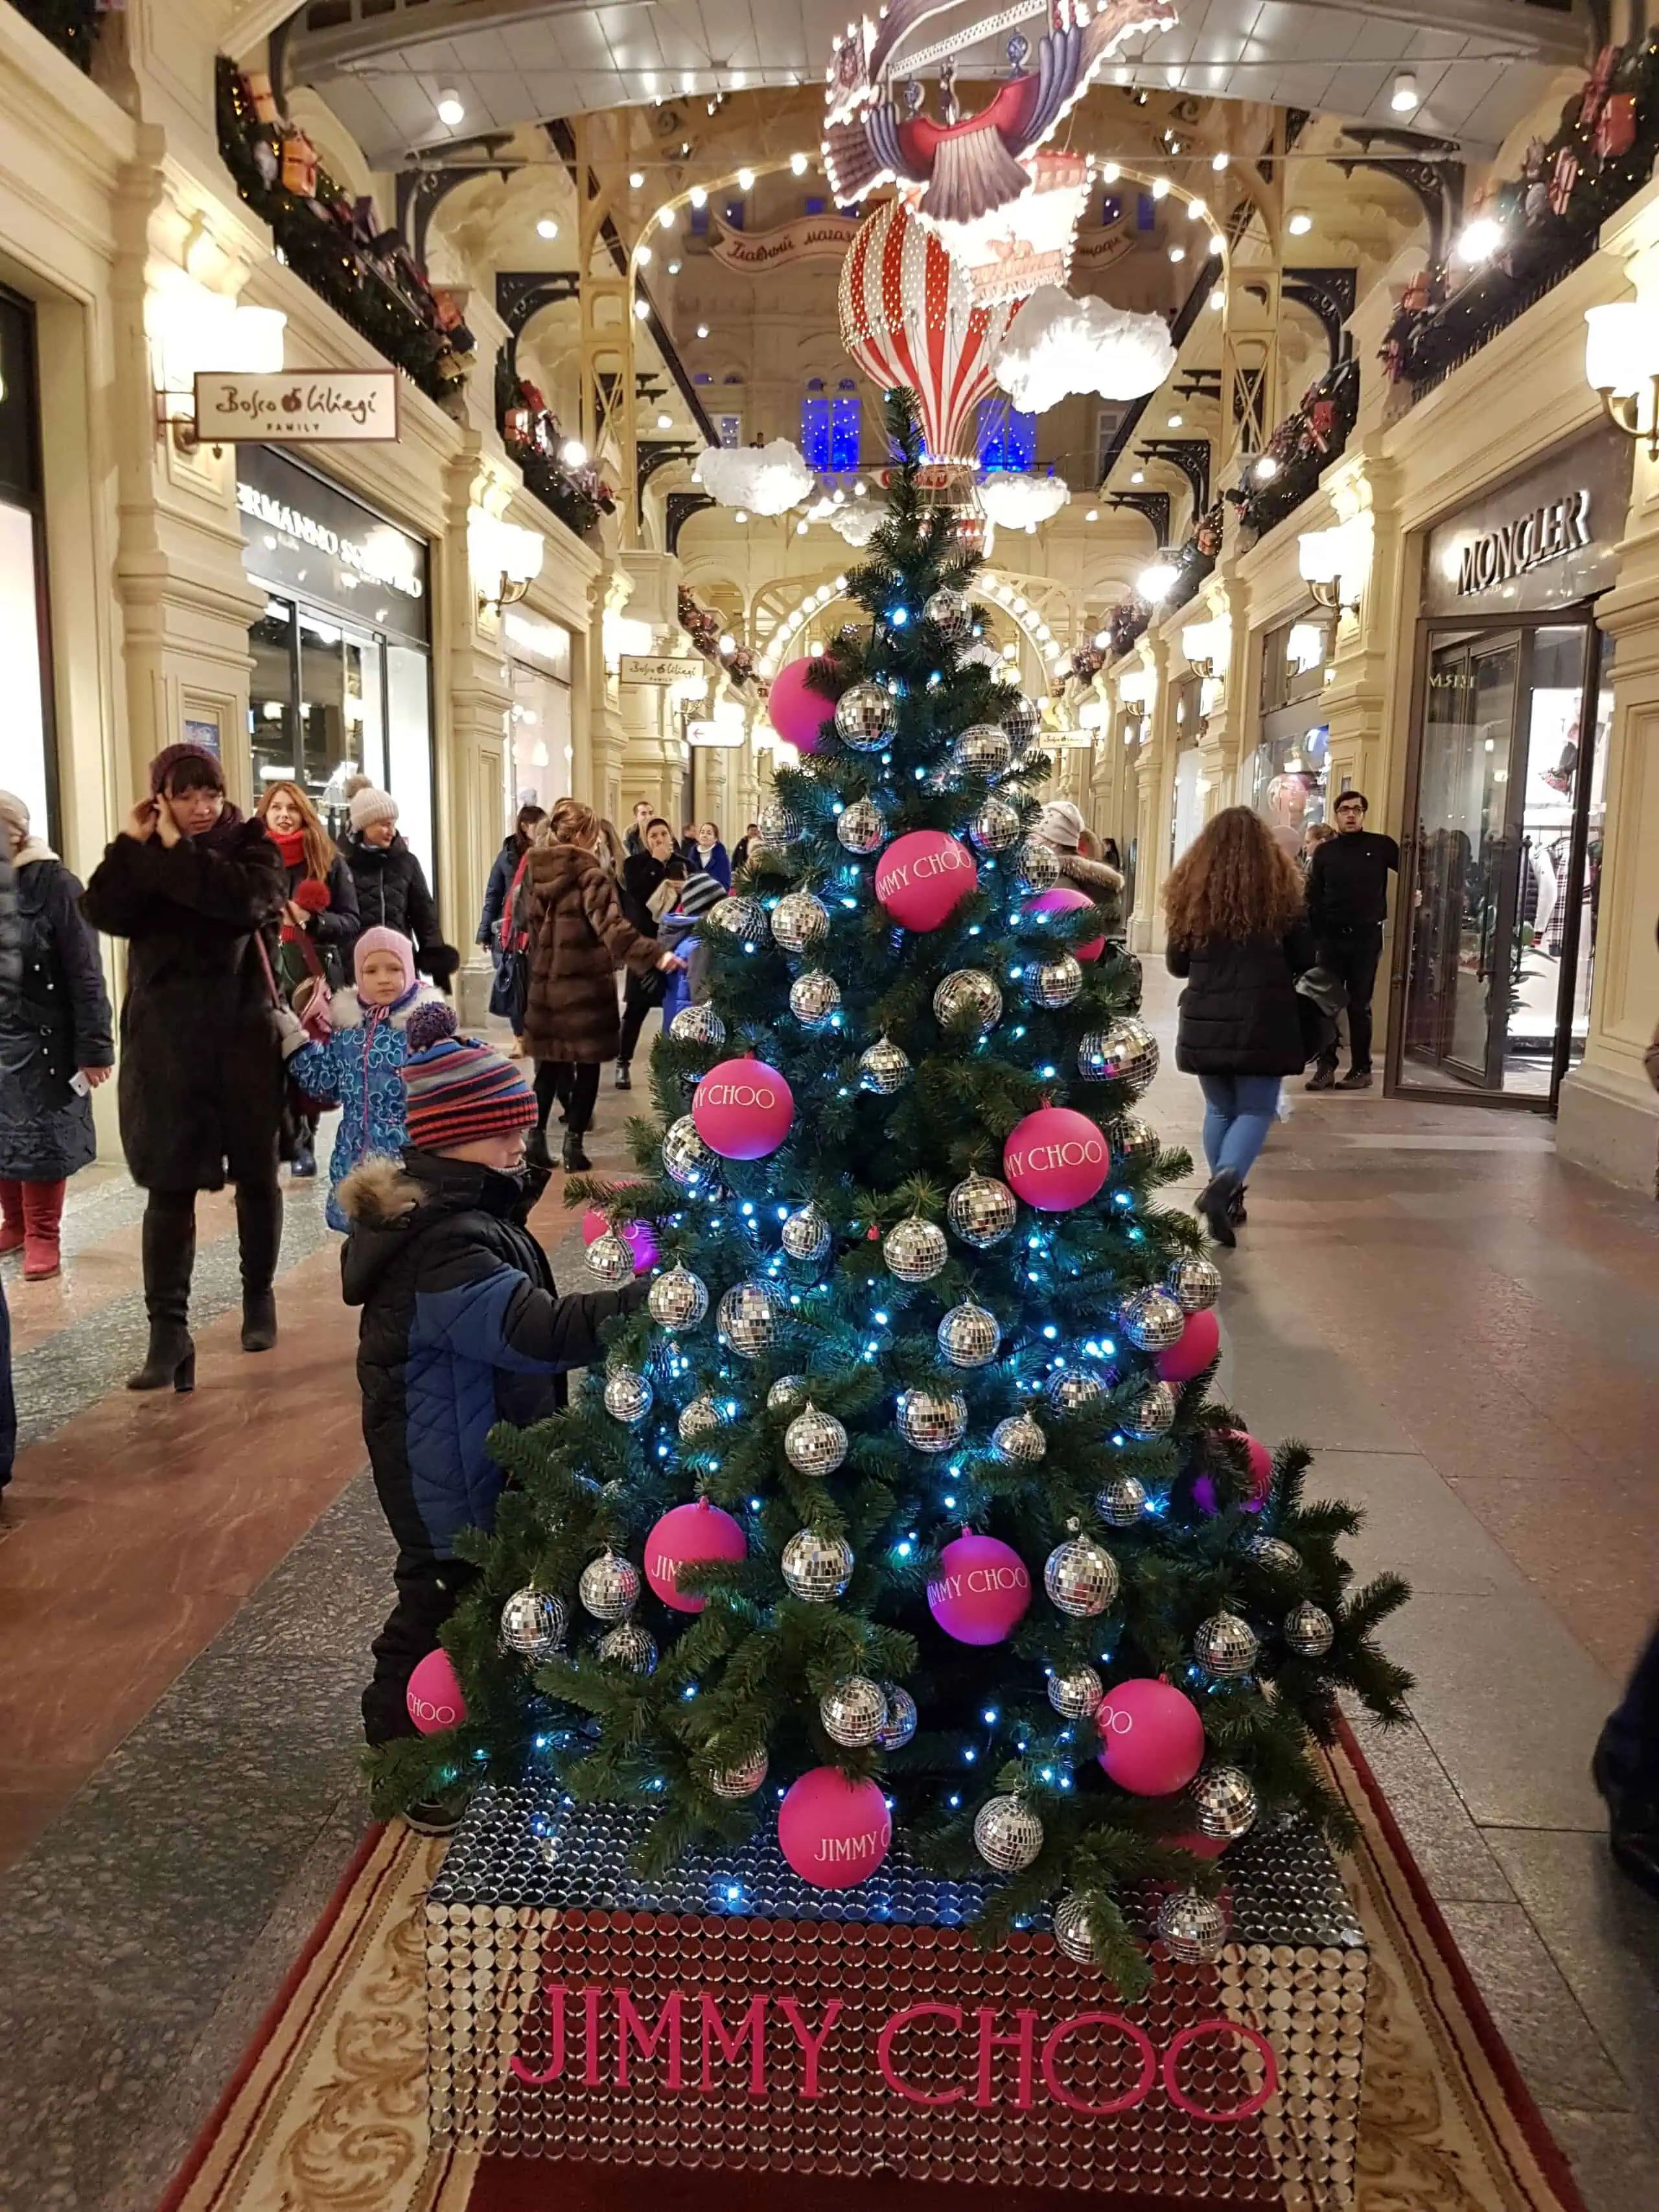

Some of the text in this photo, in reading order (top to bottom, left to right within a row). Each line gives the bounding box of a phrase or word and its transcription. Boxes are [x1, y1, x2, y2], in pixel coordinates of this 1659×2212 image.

[216, 385, 277, 419] Bosco
[266, 423, 320, 432] FAMILY
[1456, 491, 1590, 596] MONCLER
[913, 849, 971, 878] CHOO
[708, 1084, 775, 1109] CHOO
[1028, 1140, 1102, 1170] CHOO
[651, 1555, 683, 1582] JIM
[968, 1567, 1027, 1592] CHOO
[1098, 1705, 1132, 1734] OO
[814, 1831, 878, 1861] JIMMY
[510, 1985, 1279, 2121] JIMMY CHOO
